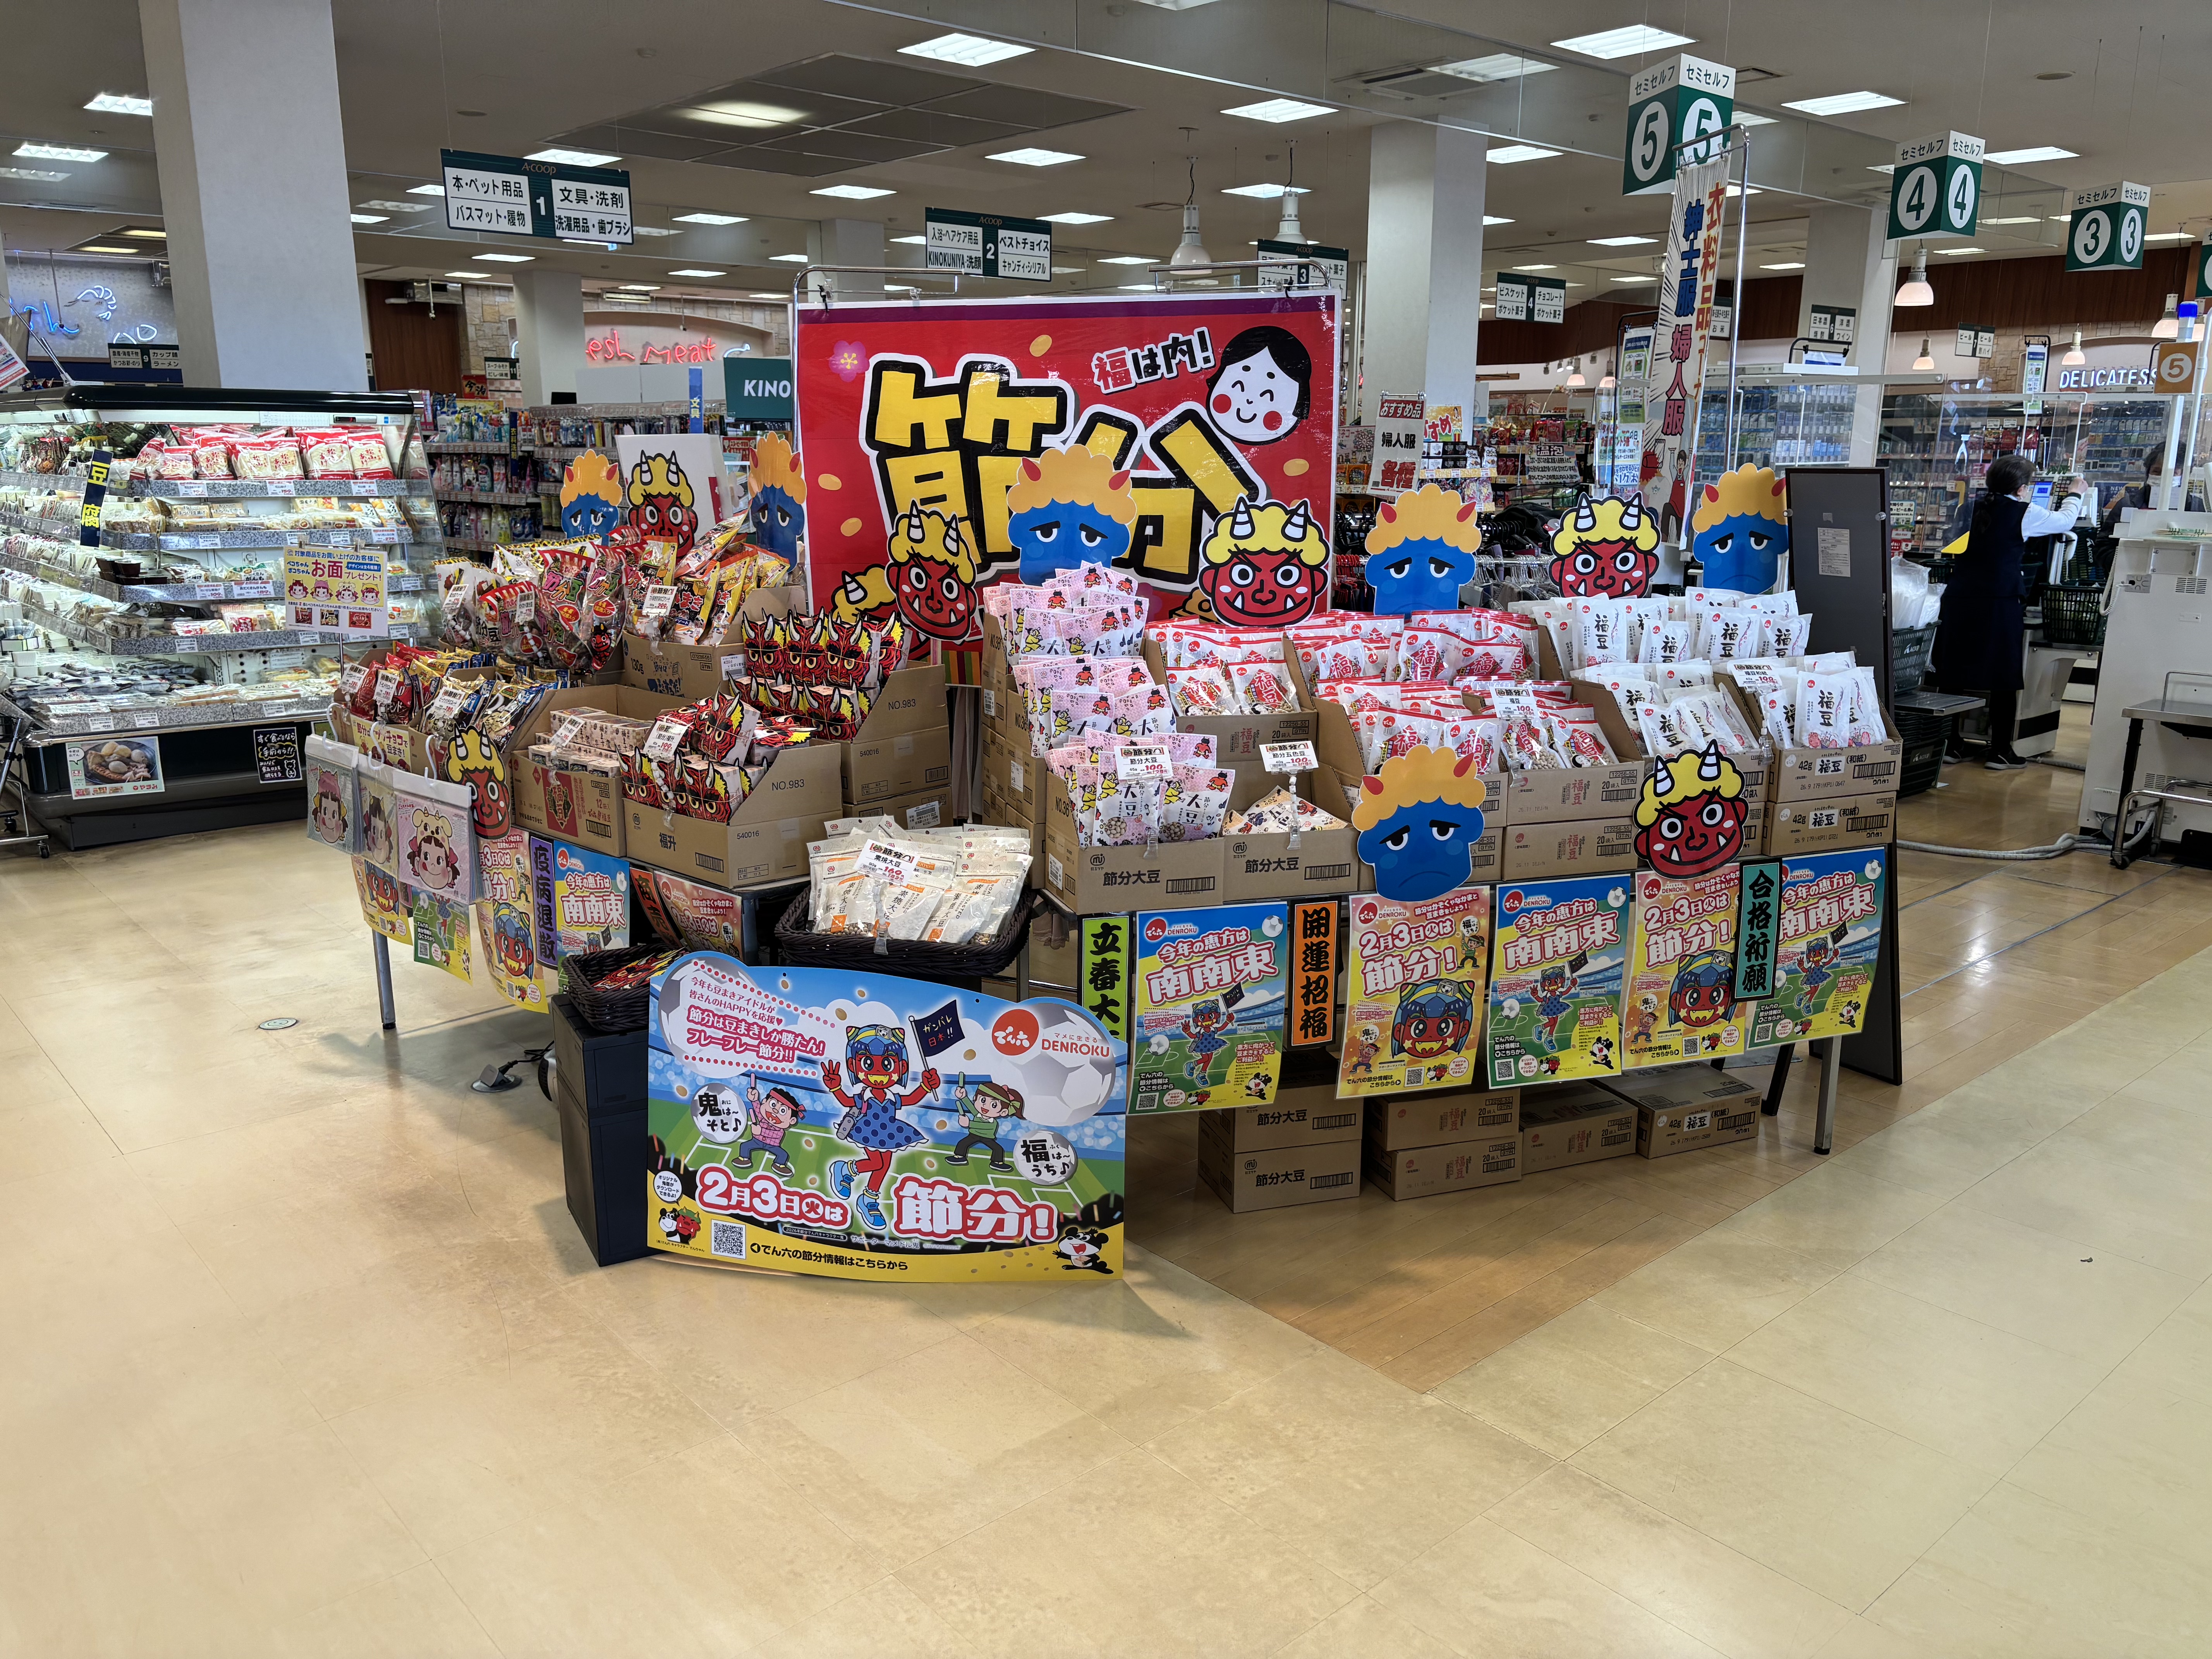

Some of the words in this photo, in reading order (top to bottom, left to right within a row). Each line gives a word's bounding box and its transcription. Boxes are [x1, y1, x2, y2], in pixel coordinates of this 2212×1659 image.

[1635, 65, 1675, 96] セミセルフ
[1686, 64, 1729, 89] セミセルフ
[1641, 111, 1659, 170] 5
[1693, 109, 1712, 165] 5
[1901, 139, 1944, 161] セミセルフ
[1953, 139, 1981, 156] セミセルフ
[452, 175, 523, 198] 本・ペット用品
[1954, 173, 1967, 220] 4
[2078, 188, 2117, 205] セミセルフ
[2125, 187, 2147, 201] セミセルフ
[536, 196, 546, 215] 1
[559, 187, 623, 208] 文具・洗剤
[1906, 174, 1925, 221] 4
[456, 205, 526, 227] バスマット・履物
[555, 215, 630, 236] 洗濯用品・歯ブラシ
[932, 227, 978, 245] 入浴・ヘアケア用品
[1000, 236, 1049, 252] ベストチョイス
[2084, 217, 2100, 256] 3
[2126, 216, 2136, 255] 3
[986, 243, 994, 259] 2
[1674, 198, 1704, 317] 紳士服
[1002, 259, 1046, 274] キャンディ・シリアル
[1300, 269, 1307, 282] 3
[1499, 287, 1524, 298] ビスケット
[1538, 291, 1562, 302] チョコレート
[1498, 304, 1523, 316] ポケット菓子
[1528, 297, 1533, 309] 4
[1537, 308, 1561, 319] ポケット菓子
[1830, 324, 1834, 333] 6
[644, 338, 716, 364] meat
[2168, 358, 2184, 378] 5
[1661, 324, 1692, 436] 婦人服
[690, 398, 700, 418] 文具
[1380, 402, 1422, 418] おすすめ品
[1382, 432, 1415, 450] 婦人服
[869, 360, 1261, 583] 節分
[1381, 460, 1415, 489] 各種
[81, 461, 110, 528] 豆腐
[311, 559, 343, 579] お面
[1595, 614, 1609, 649] 福豆
[1720, 623, 1738, 657] 福豆
[631, 658, 644, 675] 130g
[888, 698, 916, 711] NO.983
[1818, 689, 1835, 727] 福豆
[1659, 714, 1685, 747] 福豆
[386, 744, 405, 757] 豆まき!
[1240, 728, 1252, 754] 福豆
[860, 748, 879, 757] 540016
[1846, 754, 1867, 764] (和紙)
[1798, 761, 1813, 771] 42g
[1818, 759, 1842, 773] 福豆
[771, 779, 805, 792] NO.983
[1572, 780, 1583, 805] 福豆
[1122, 784, 1138, 818] 大豆
[1182, 794, 1202, 825] 大豆
[1793, 814, 1806, 824] 42g
[1812, 813, 1835, 827] 福豆
[659, 832, 676, 851] 福升
[737, 830, 759, 840] 540016
[1567, 835, 1578, 860] 福豆
[1245, 857, 1299, 873] 節分大豆
[566, 873, 611, 891] 今年の恵方は
[1103, 870, 1161, 886] 節分大豆
[1783, 872, 1854, 901] 今年の恵方は
[534, 846, 555, 960] 疫病退散
[562, 893, 626, 927] 南南東
[1379, 910, 1407, 919] DENROKU
[1167, 927, 1197, 935] DENROKU
[1505, 913, 1618, 969] 南南東
[1743, 869, 1775, 993] 合格祈願
[1161, 928, 1249, 962] 今年の恵方は
[1148, 943, 1275, 1003] 南南東
[1300, 907, 1331, 1039] 開運招福
[1364, 946, 1456, 995] 節分!
[1089, 922, 1122, 1042] 立春大
[691, 977, 775, 1013] 今年も豆まきアイドルが
[689, 1008, 824, 1054] 節分は豆まきしか勝たん!
[923, 1015, 952, 1033] ガンバレ
[688, 1030, 793, 1061] フレーフレー節分!!
[928, 1030, 953, 1046] 日本!!
[994, 1026, 1030, 1048] でん六
[1054, 1033, 1097, 1043] マメに生きる
[1237, 1042, 1274, 1050] 恵方に向かって
[1041, 1039, 1109, 1057] DENROKU
[1346, 1075, 1393, 1084] でん六の節分情報は
[1257, 1109, 1307, 1126] 節分大豆
[1669, 1120, 1681, 1128] 42g
[1686, 1115, 1708, 1130] 福豆
[1256, 1169, 1305, 1187] 節分大豆
[900, 1183, 1048, 1236] 節分!
[761, 1244, 908, 1270] でん六の節分情報はこちらから
